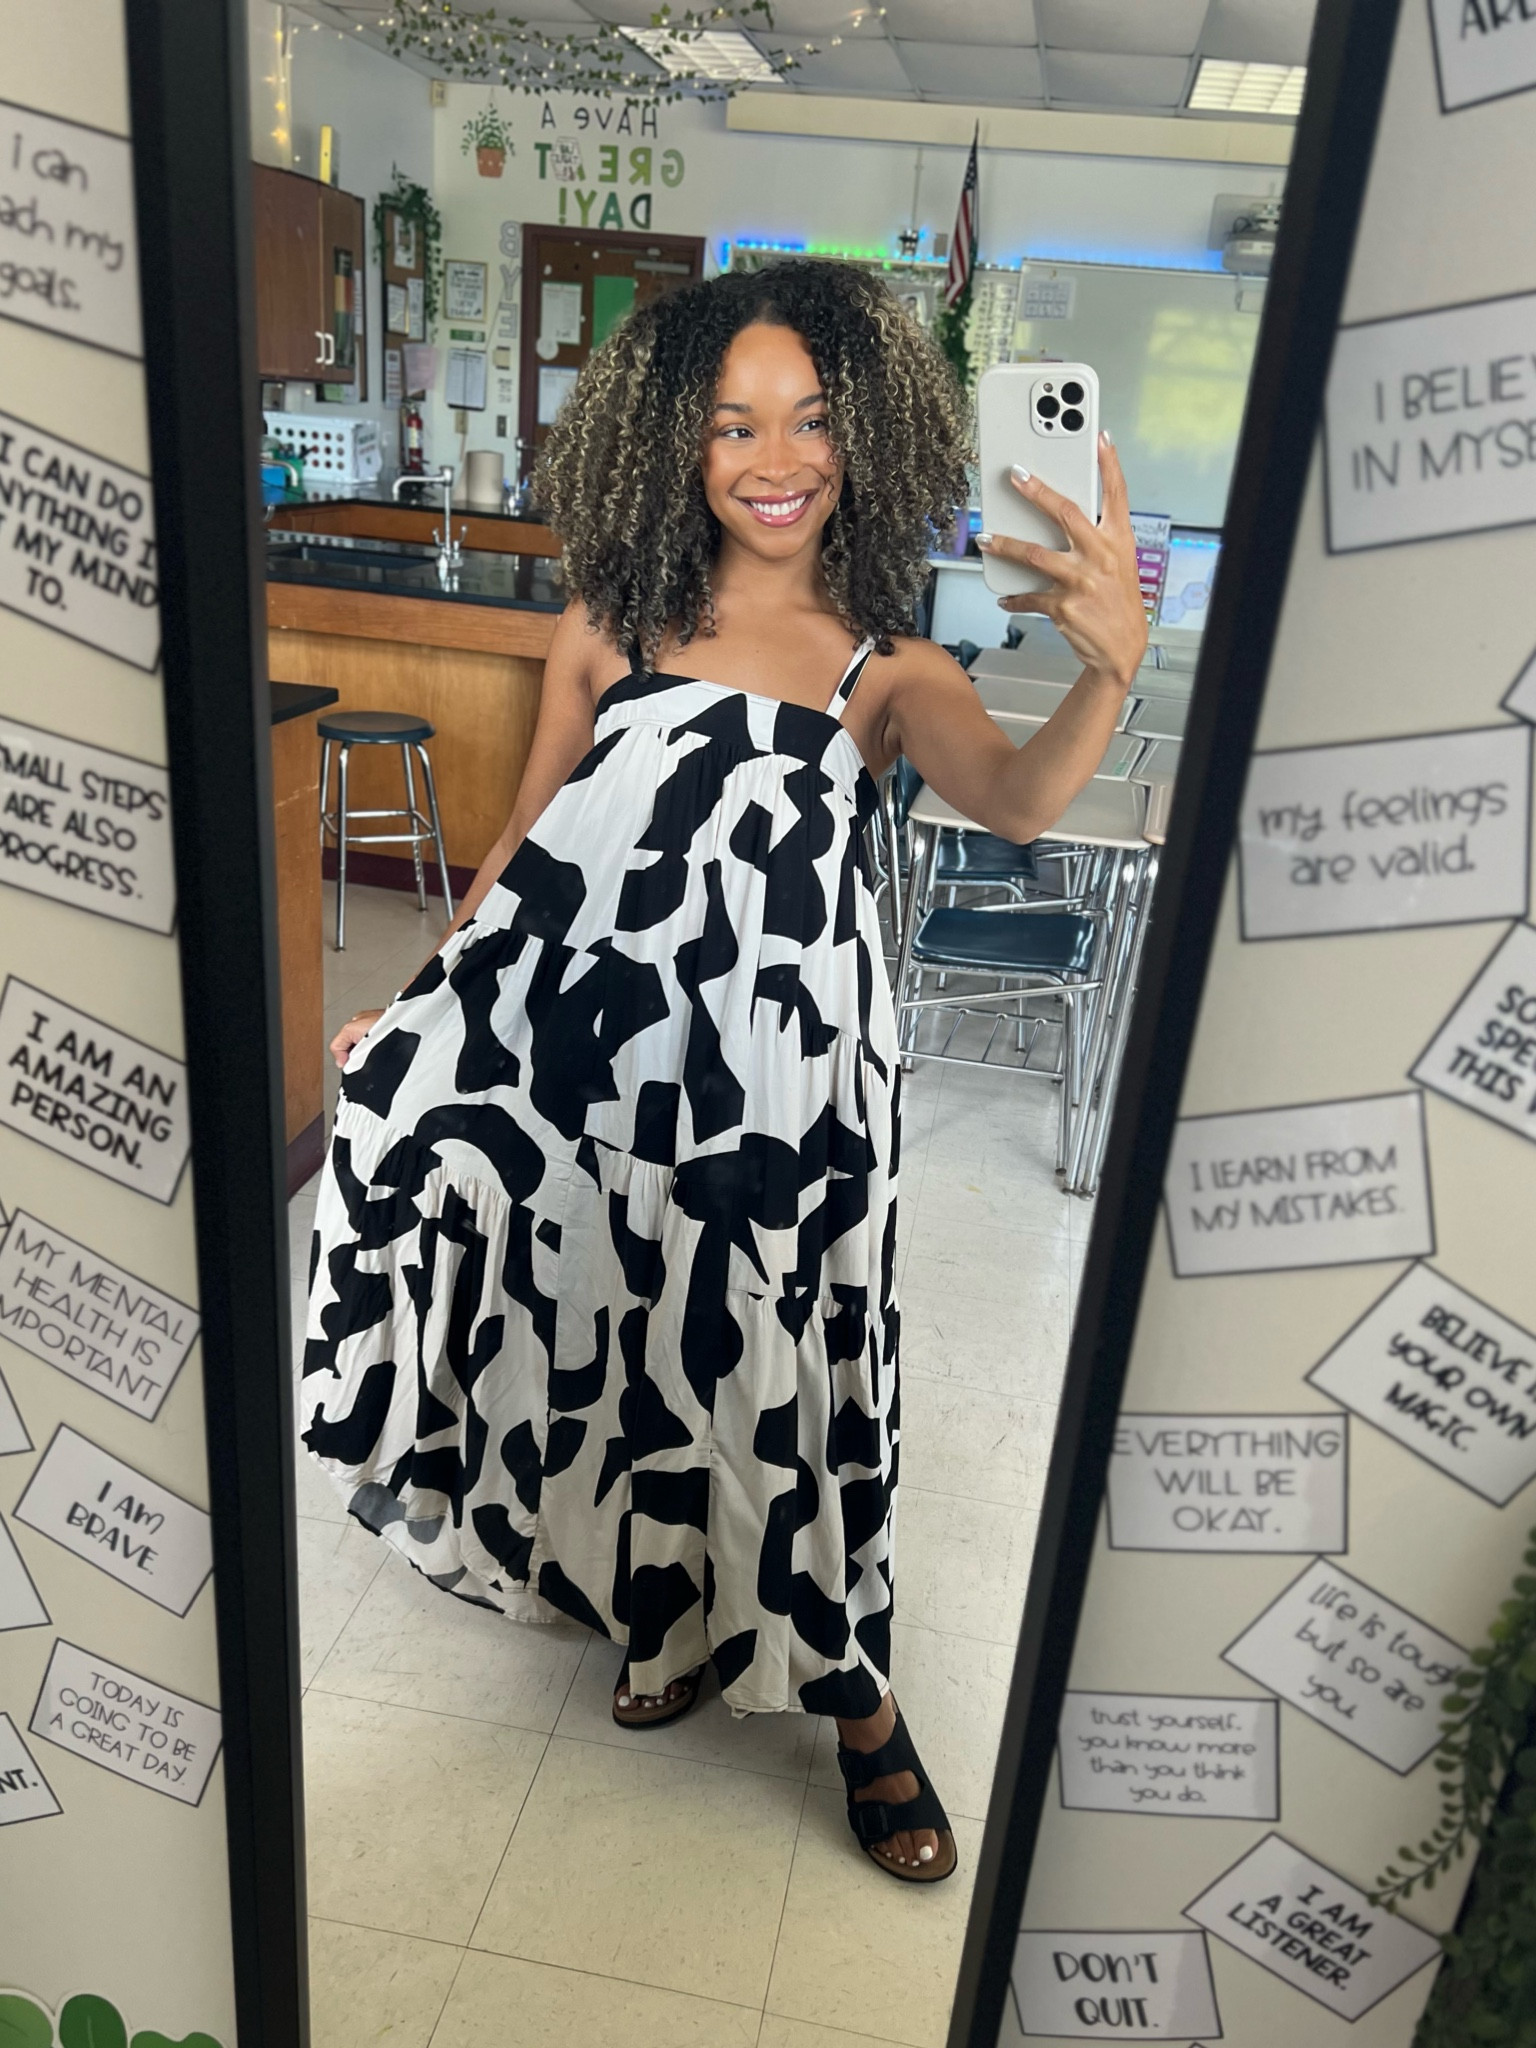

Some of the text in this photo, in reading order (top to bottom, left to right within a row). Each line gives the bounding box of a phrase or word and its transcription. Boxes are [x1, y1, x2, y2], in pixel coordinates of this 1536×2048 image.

[32, 149, 88, 192] can
[66, 222, 124, 271] my
[1376, 353, 1536, 423] I BELIE
[0, 431, 143, 522] I CAN DO
[1352, 440, 1400, 492] IN
[12, 523, 157, 608] MY MIND
[26, 565, 67, 611] TO.
[0, 744, 167, 821] MALL STEPS
[3, 791, 137, 851] ARE ALSO
[1258, 781, 1508, 842] my feelings
[1290, 833, 1476, 887] are valid.
[26, 1011, 177, 1108] I AM AN
[1477, 1019, 1536, 1067] SPE
[8, 1044, 173, 1143] AMAZING
[1447, 1045, 1524, 1101] THIS
[11, 1081, 143, 1170] PERSON.
[1190, 1145, 1397, 1192] I LEARN FROM
[1191, 1199, 1240, 1232] MY
[15, 1228, 184, 1346] MY MENTAL
[13, 1267, 161, 1366] HEALTH IS
[1420, 1305, 1533, 1384] BELIEVE
[1384, 1382, 1477, 1452] MAGIC.
[1465, 1386, 1536, 1439] OWN
[1111, 1429, 1341, 1458] EVERYTHING
[98, 1481, 112, 1503] I
[1154, 1468, 1296, 1496] WILL BE
[66, 1502, 159, 1575] BRAVE.
[1172, 1506, 1283, 1534] OKAY.
[1295, 1617, 1425, 1712] but so are
[1358, 1612, 1387, 1640] is
[1388, 1630, 1462, 1686] toug
[59, 1687, 197, 1762] GOING TO BE
[91, 1671, 185, 1728] TODAY IS
[1090, 1707, 1242, 1731] trust yourself.
[50, 1712, 63, 1730] A
[71, 1720, 140, 1762] GREAT
[1078, 1734, 1257, 1755] you know more
[1090, 1756, 1246, 1780] than you think
[1130, 1786, 1170, 1803] you
[1258, 1895, 1372, 1966] A GREAT
[1297, 1884, 1374, 1940] I AM
[1227, 1902, 1351, 1991] LISTENER.
[1075, 1997, 1159, 2028] QUIT.
